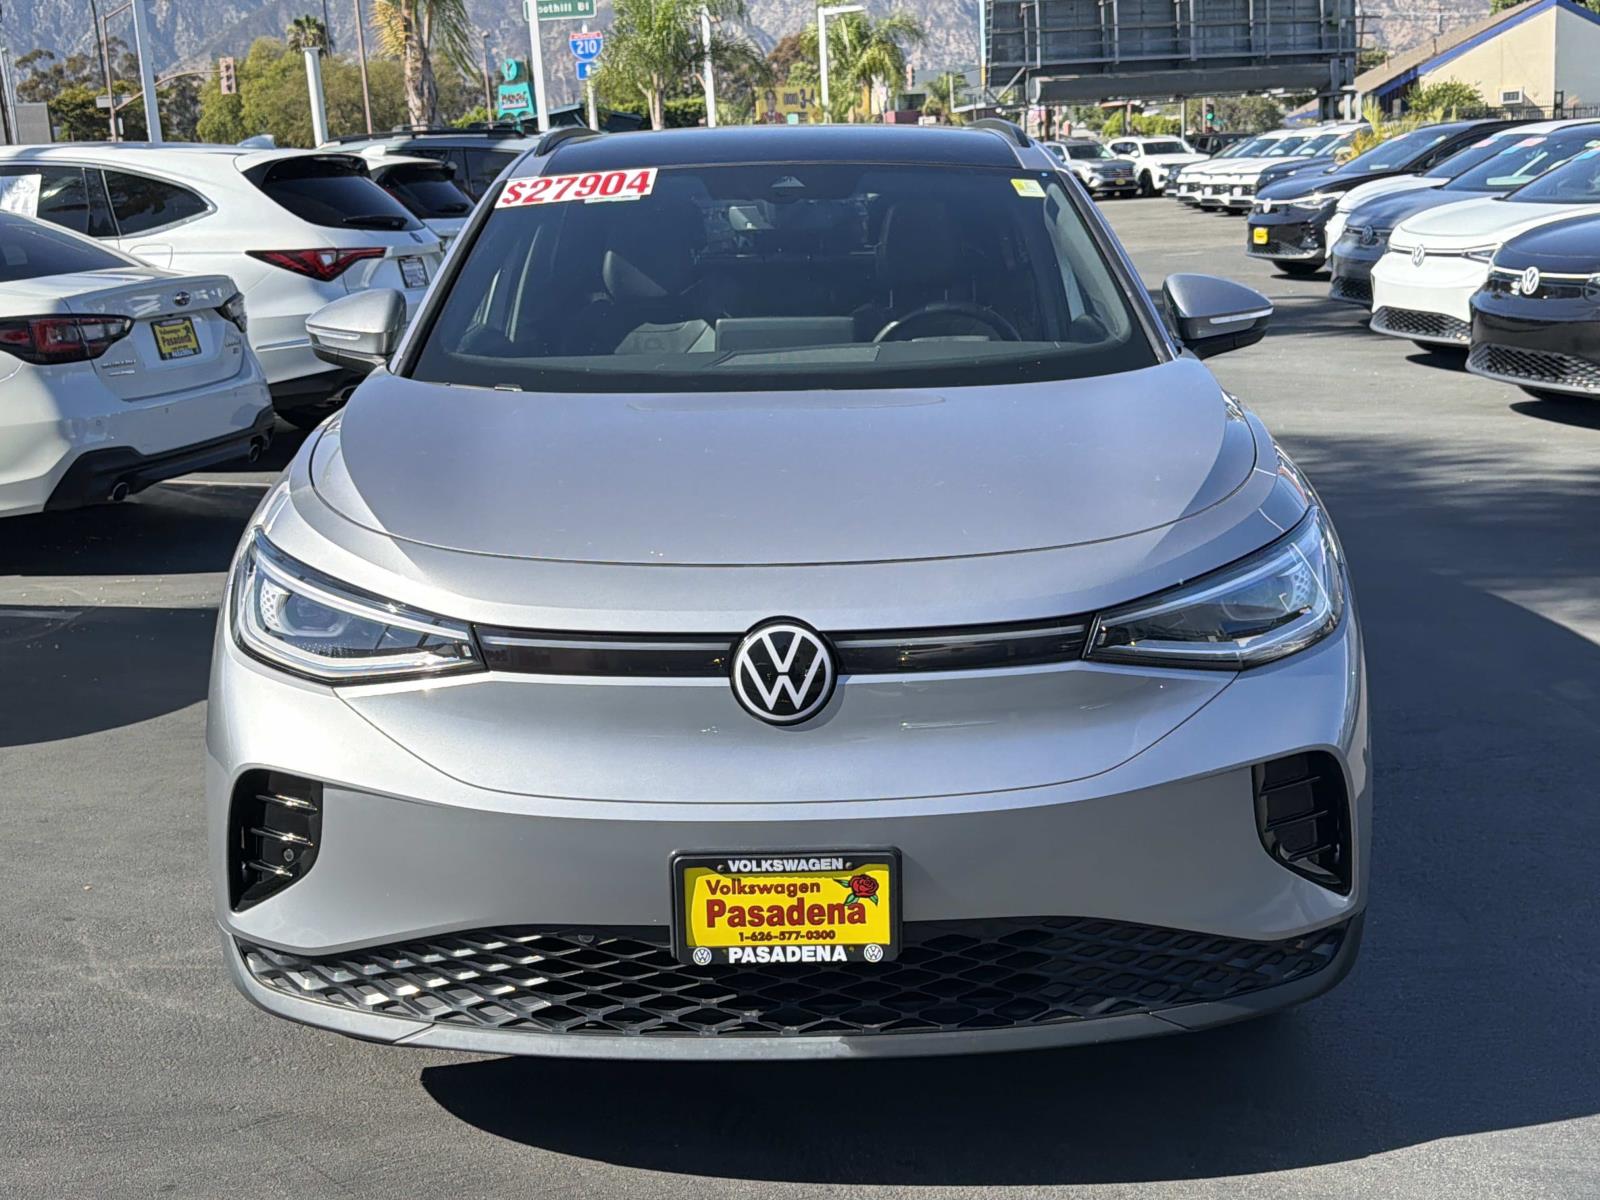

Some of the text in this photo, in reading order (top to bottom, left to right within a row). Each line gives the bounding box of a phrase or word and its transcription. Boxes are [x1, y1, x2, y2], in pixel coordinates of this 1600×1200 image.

[575, 40, 598, 55] 210
[502, 171, 650, 204] $27904
[727, 858, 844, 873] VOLKSWAGEN
[706, 879, 821, 897] Volkswagen
[706, 898, 867, 928] Pasadena
[738, 930, 836, 942] 1-626-577-0300
[728, 945, 848, 964] PASADENA
